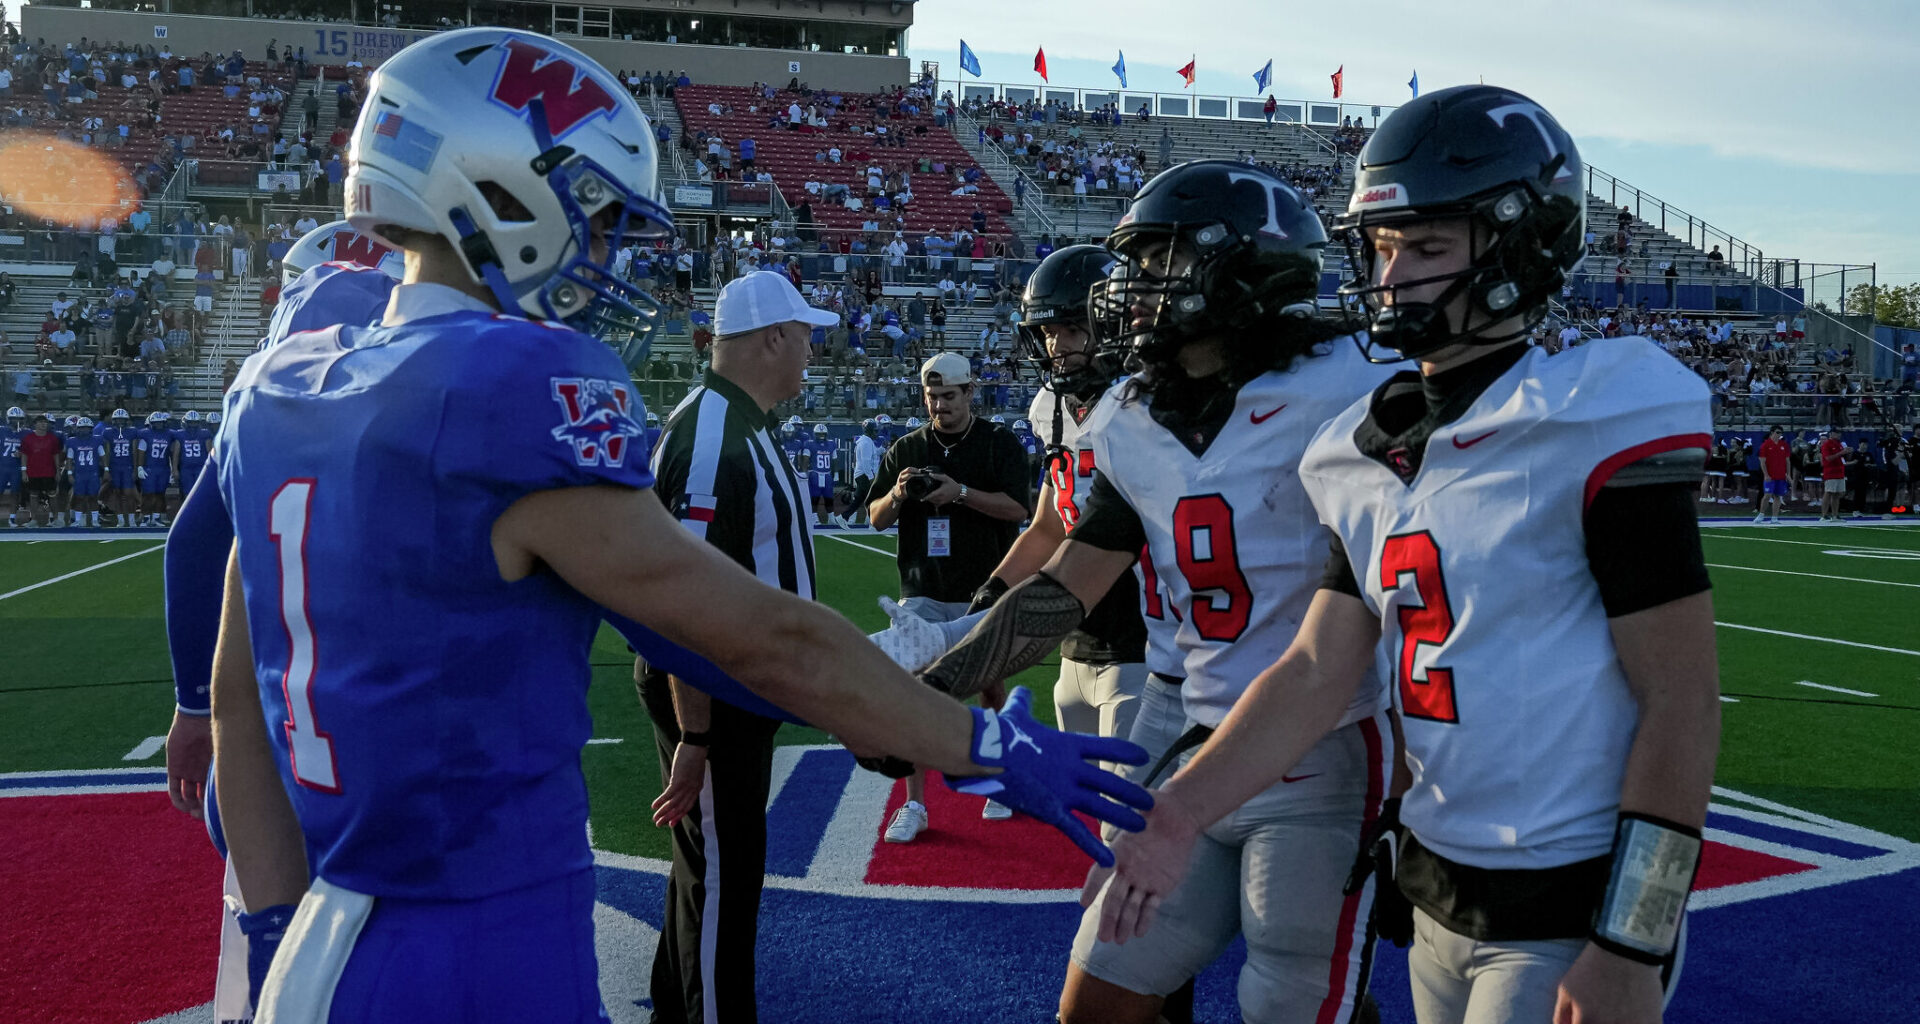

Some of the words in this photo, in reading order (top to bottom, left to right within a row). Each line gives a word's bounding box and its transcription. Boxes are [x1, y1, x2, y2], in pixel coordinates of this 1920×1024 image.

[155, 28, 166, 37] W
[352, 32, 406, 49] DREW
[314, 29, 348, 56] 15
[790, 63, 799, 72] S
[487, 33, 623, 146] W
[1484, 101, 1574, 184] T
[1356, 186, 1398, 204] iddell
[1228, 172, 1301, 240] T
[332, 229, 395, 269] W
[3, 442, 22, 458] 75
[78, 450, 94, 466] 44
[151, 443, 169, 459] 67
[184, 443, 201, 458] 59
[816, 454, 831, 469] 60
[1172, 492, 1254, 643] 9
[1380, 528, 1460, 724] 2
[268, 477, 344, 795] 1
